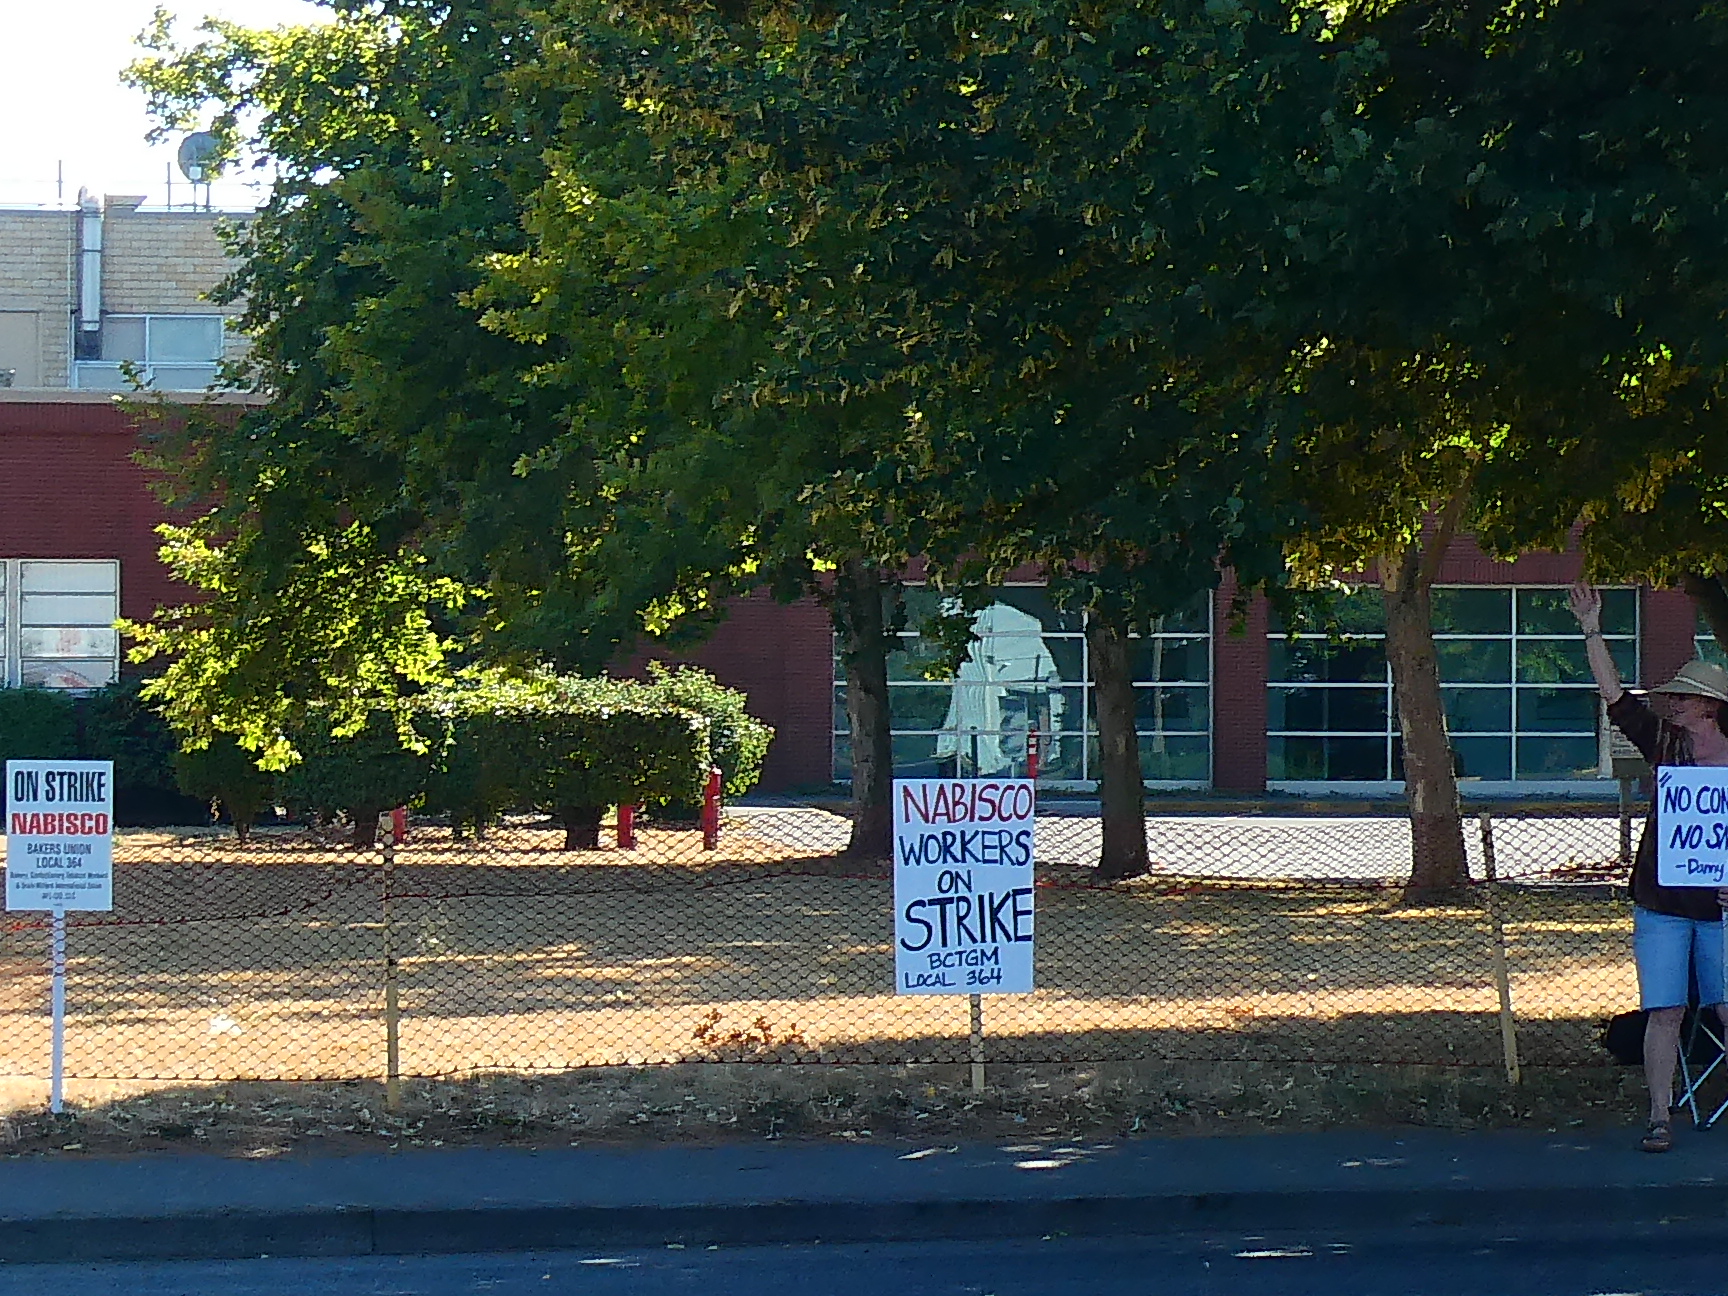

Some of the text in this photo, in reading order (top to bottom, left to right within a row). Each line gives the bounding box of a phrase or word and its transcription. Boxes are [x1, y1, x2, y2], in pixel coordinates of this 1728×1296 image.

[14, 770, 107, 802] ON STRIKE
[902, 782, 1033, 825] NABISCO
[11, 812, 109, 836] NABISCO
[27, 843, 92, 855] BAKERS UNION
[898, 829, 1032, 867] WORKERS
[1669, 824, 1704, 850] NO
[36, 856, 64, 869] LOCAL
[937, 869, 972, 894] ON
[900, 887, 1033, 952] STRIKE
[927, 946, 1000, 970] BCTGM
[904, 968, 1003, 989] LOCAL 364
